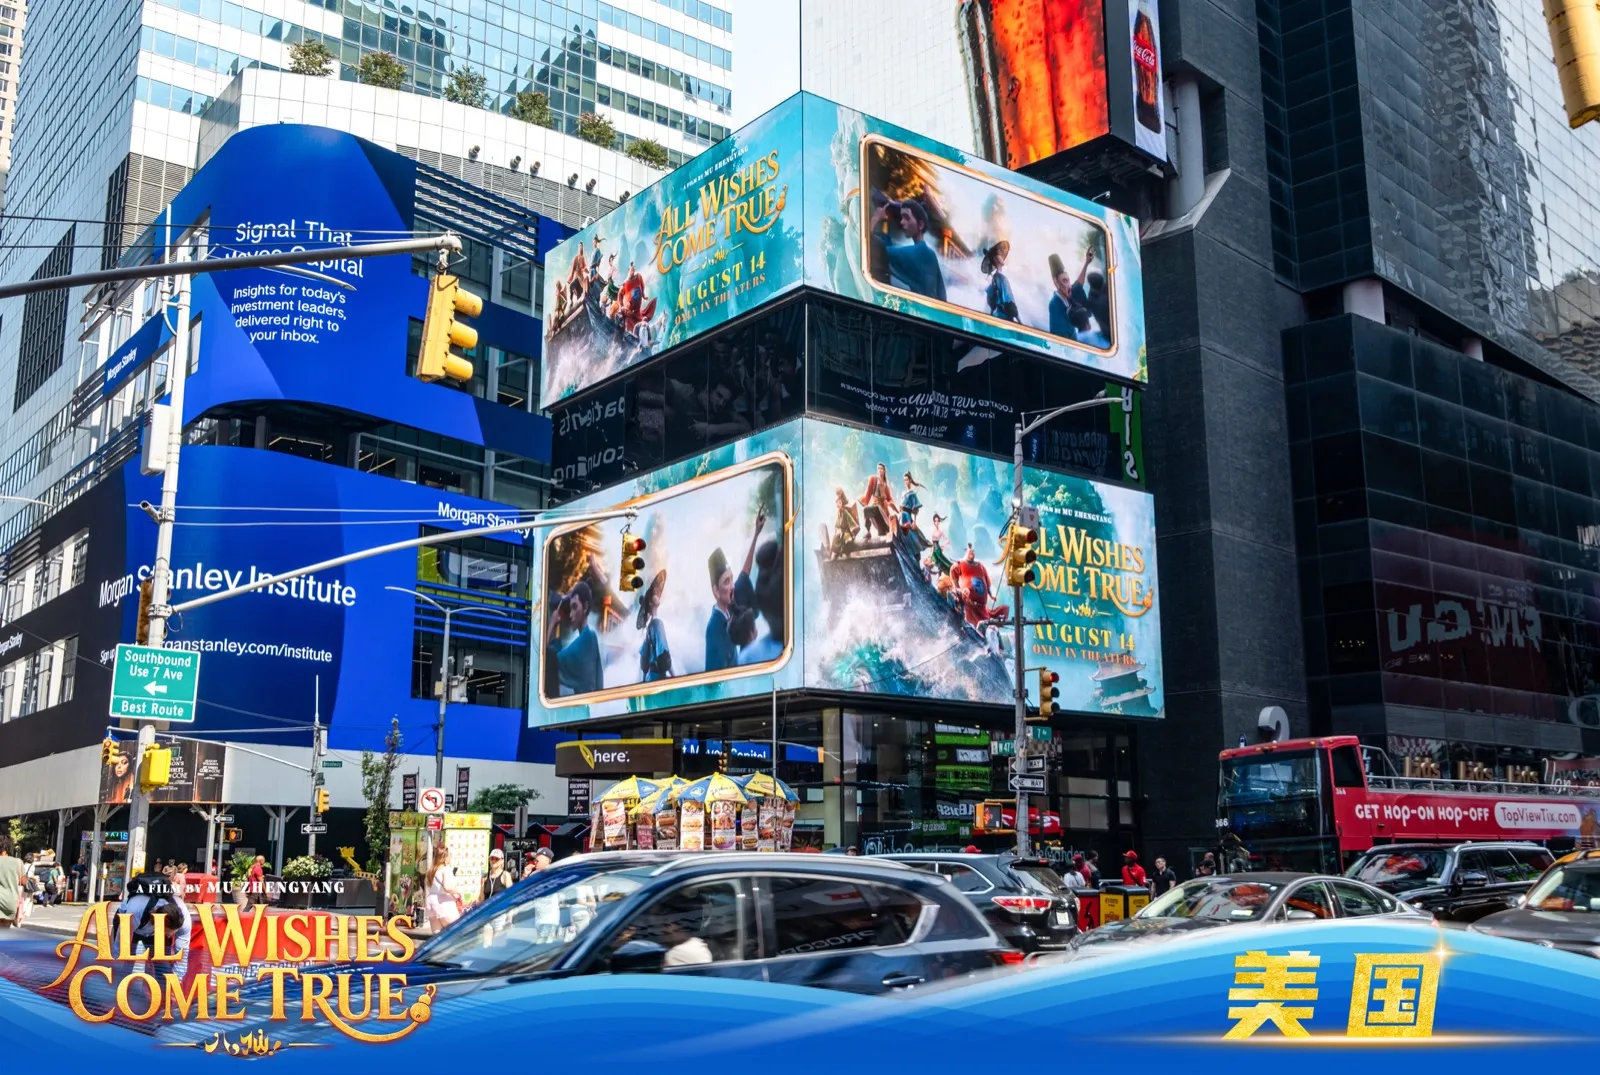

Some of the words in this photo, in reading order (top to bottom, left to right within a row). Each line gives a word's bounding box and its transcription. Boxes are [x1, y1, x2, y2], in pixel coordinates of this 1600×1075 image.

[704, 168, 714, 178] MU
[653, 200, 696, 252] ALL
[699, 150, 779, 220] WISHES
[235, 219, 296, 244] Signal
[304, 220, 353, 248] That
[657, 218, 717, 275] COME
[720, 185, 784, 238] TRUE
[676, 262, 743, 312] AUGUST
[750, 251, 766, 275] 14
[233, 284, 276, 299] Insights
[279, 284, 298, 295] for
[301, 286, 346, 304] today's
[675, 307, 698, 325] ONLY
[700, 299, 712, 313] IN
[713, 272, 766, 306] THEATERS
[231, 301, 294, 314] investment
[297, 300, 347, 320] leaders,
[235, 314, 290, 328] delivered
[293, 315, 324, 330] right
[327, 320, 340, 332] to
[249, 330, 278, 344] your
[281, 329, 319, 344] inbox.
[107, 361, 122, 382] Morgan
[121, 347, 137, 368] Stanley
[438, 501, 485, 526] Morgan
[1062, 508, 1073, 516] MU
[1056, 524, 1145, 574] WISHES
[98, 574, 134, 608] Morgan
[251, 565, 357, 606] Institute
[1022, 561, 1080, 596] OME
[1084, 566, 1149, 613] TRUE
[1033, 623, 1112, 648] AUGUST
[1119, 632, 1135, 651] 14
[124, 649, 192, 668] Southbound
[160, 638, 333, 663] rganstanley.com/institute
[1032, 644, 1061, 657] ONLY
[1065, 647, 1077, 659] IN
[1081, 649, 1136, 665] THEATERS
[129, 664, 149, 677] Use
[152, 667, 160, 678] 7
[163, 669, 183, 680] Ave
[121, 700, 147, 714] Best
[151, 703, 184, 716] Route
[1003, 742, 1010, 752] 47
[1013, 778, 1025, 786] ONE
[1354, 804, 1379, 819] GET
[1500, 807, 1578, 824] TopViewTix.com
